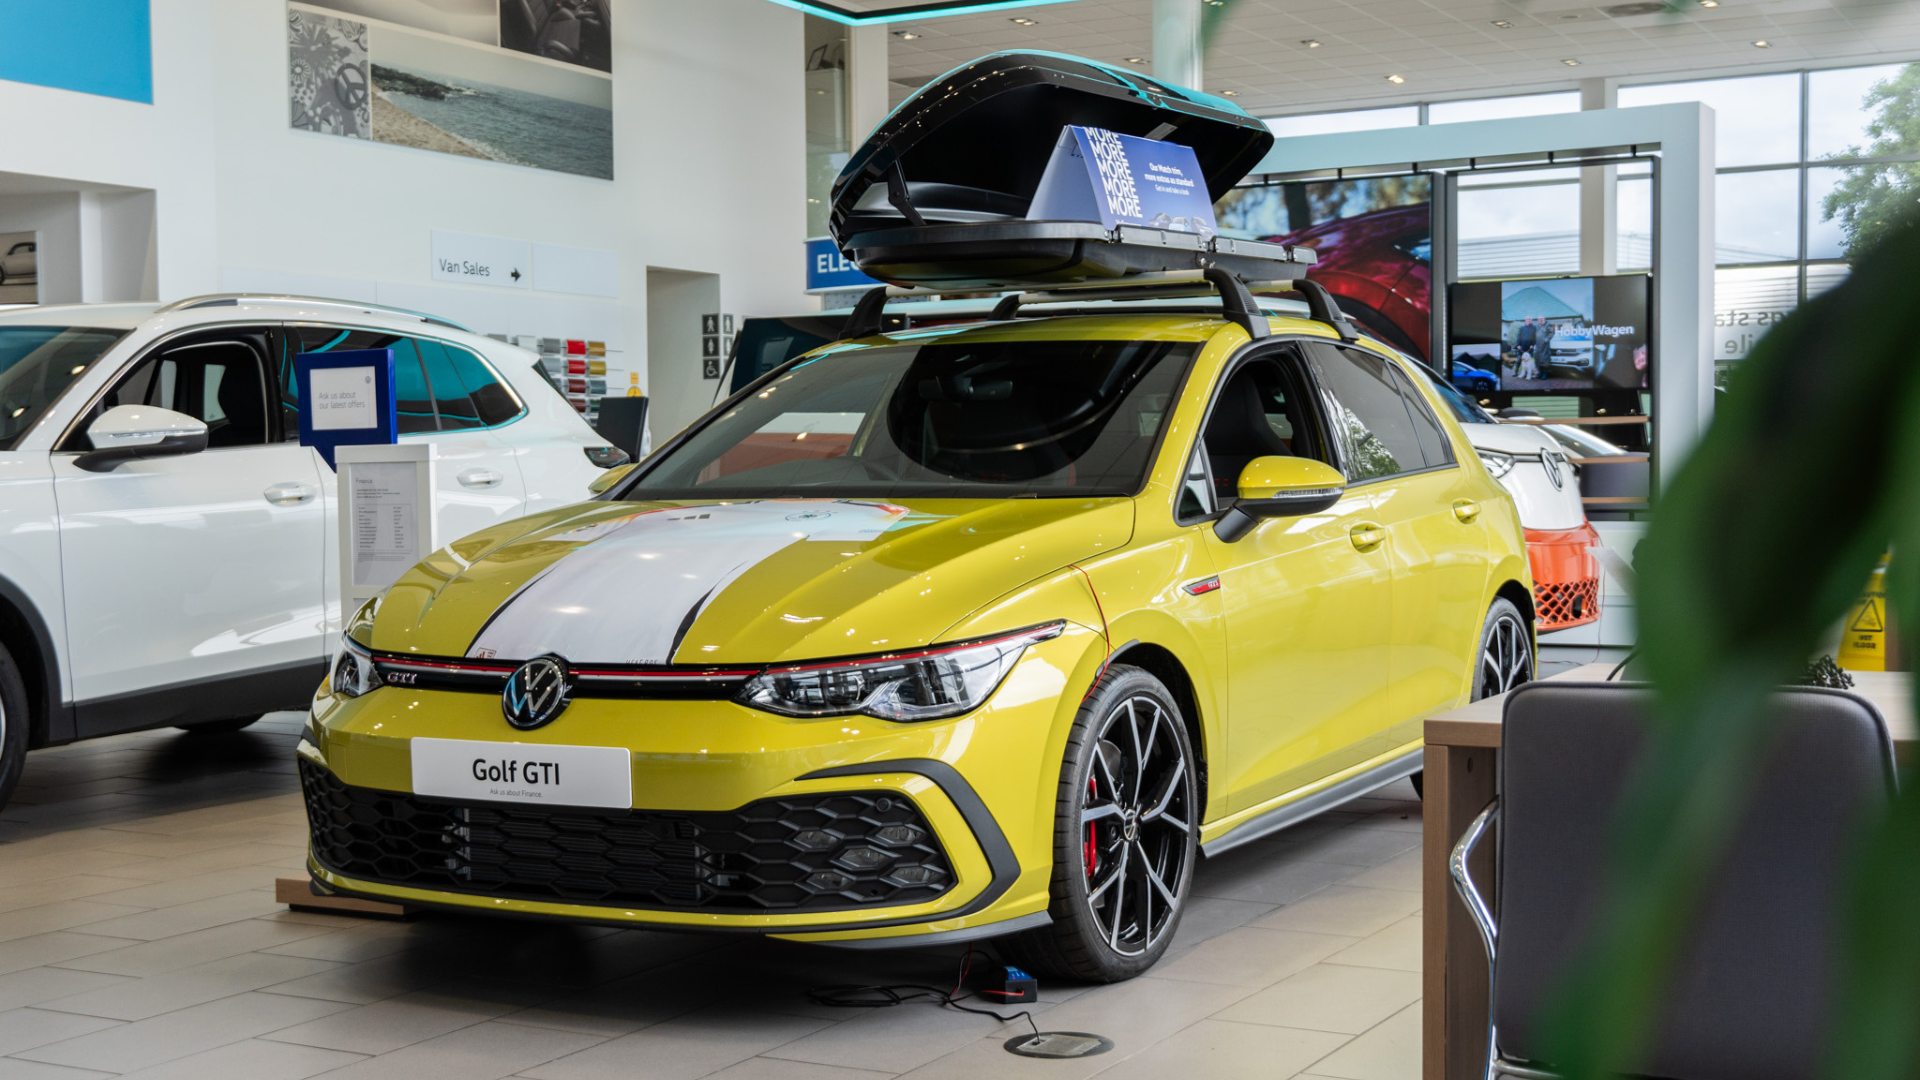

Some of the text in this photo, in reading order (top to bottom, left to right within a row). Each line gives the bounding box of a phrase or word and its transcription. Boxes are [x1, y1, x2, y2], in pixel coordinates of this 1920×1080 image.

[1083, 127, 1122, 145] MORE
[1089, 140, 1128, 162] MORE
[1096, 158, 1134, 180] MORE
[1102, 176, 1139, 199] MORE
[1107, 194, 1143, 218] MORE
[438, 258, 490, 276] Van Sales
[1554, 324, 1634, 338] HobbyWagen
[319, 392, 329, 400] Ask
[339, 391, 356, 399] about
[330, 401, 346, 409] latest
[347, 400, 365, 409] offers
[386, 671, 418, 685] GTI
[472, 758, 560, 786] Golf GTI
[506, 789, 521, 797] about
